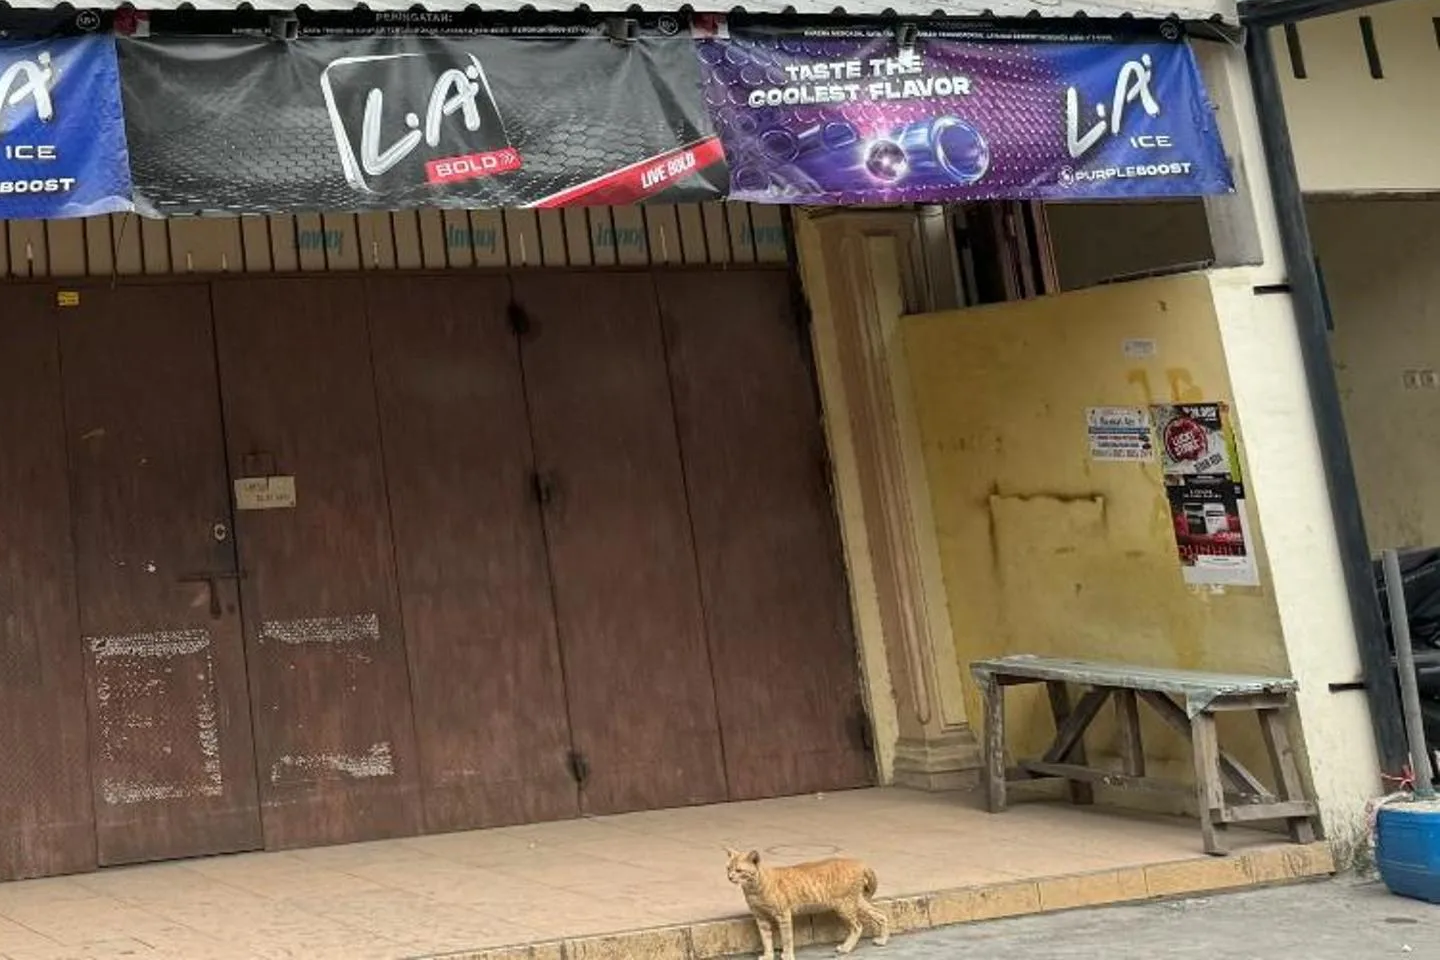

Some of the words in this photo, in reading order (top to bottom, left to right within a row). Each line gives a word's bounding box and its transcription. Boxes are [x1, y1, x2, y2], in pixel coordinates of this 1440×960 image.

[784, 60, 862, 82] TASTE
[867, 55, 923, 76] THE
[747, 83, 862, 108] COOLEST
[868, 75, 973, 101] FLAVOR
[5, 143, 58, 161] ICE
[1129, 134, 1173, 149] ICE
[434, 156, 498, 179] BOLD
[639, 164, 668, 192] LIVE
[666, 153, 698, 185] BOLD
